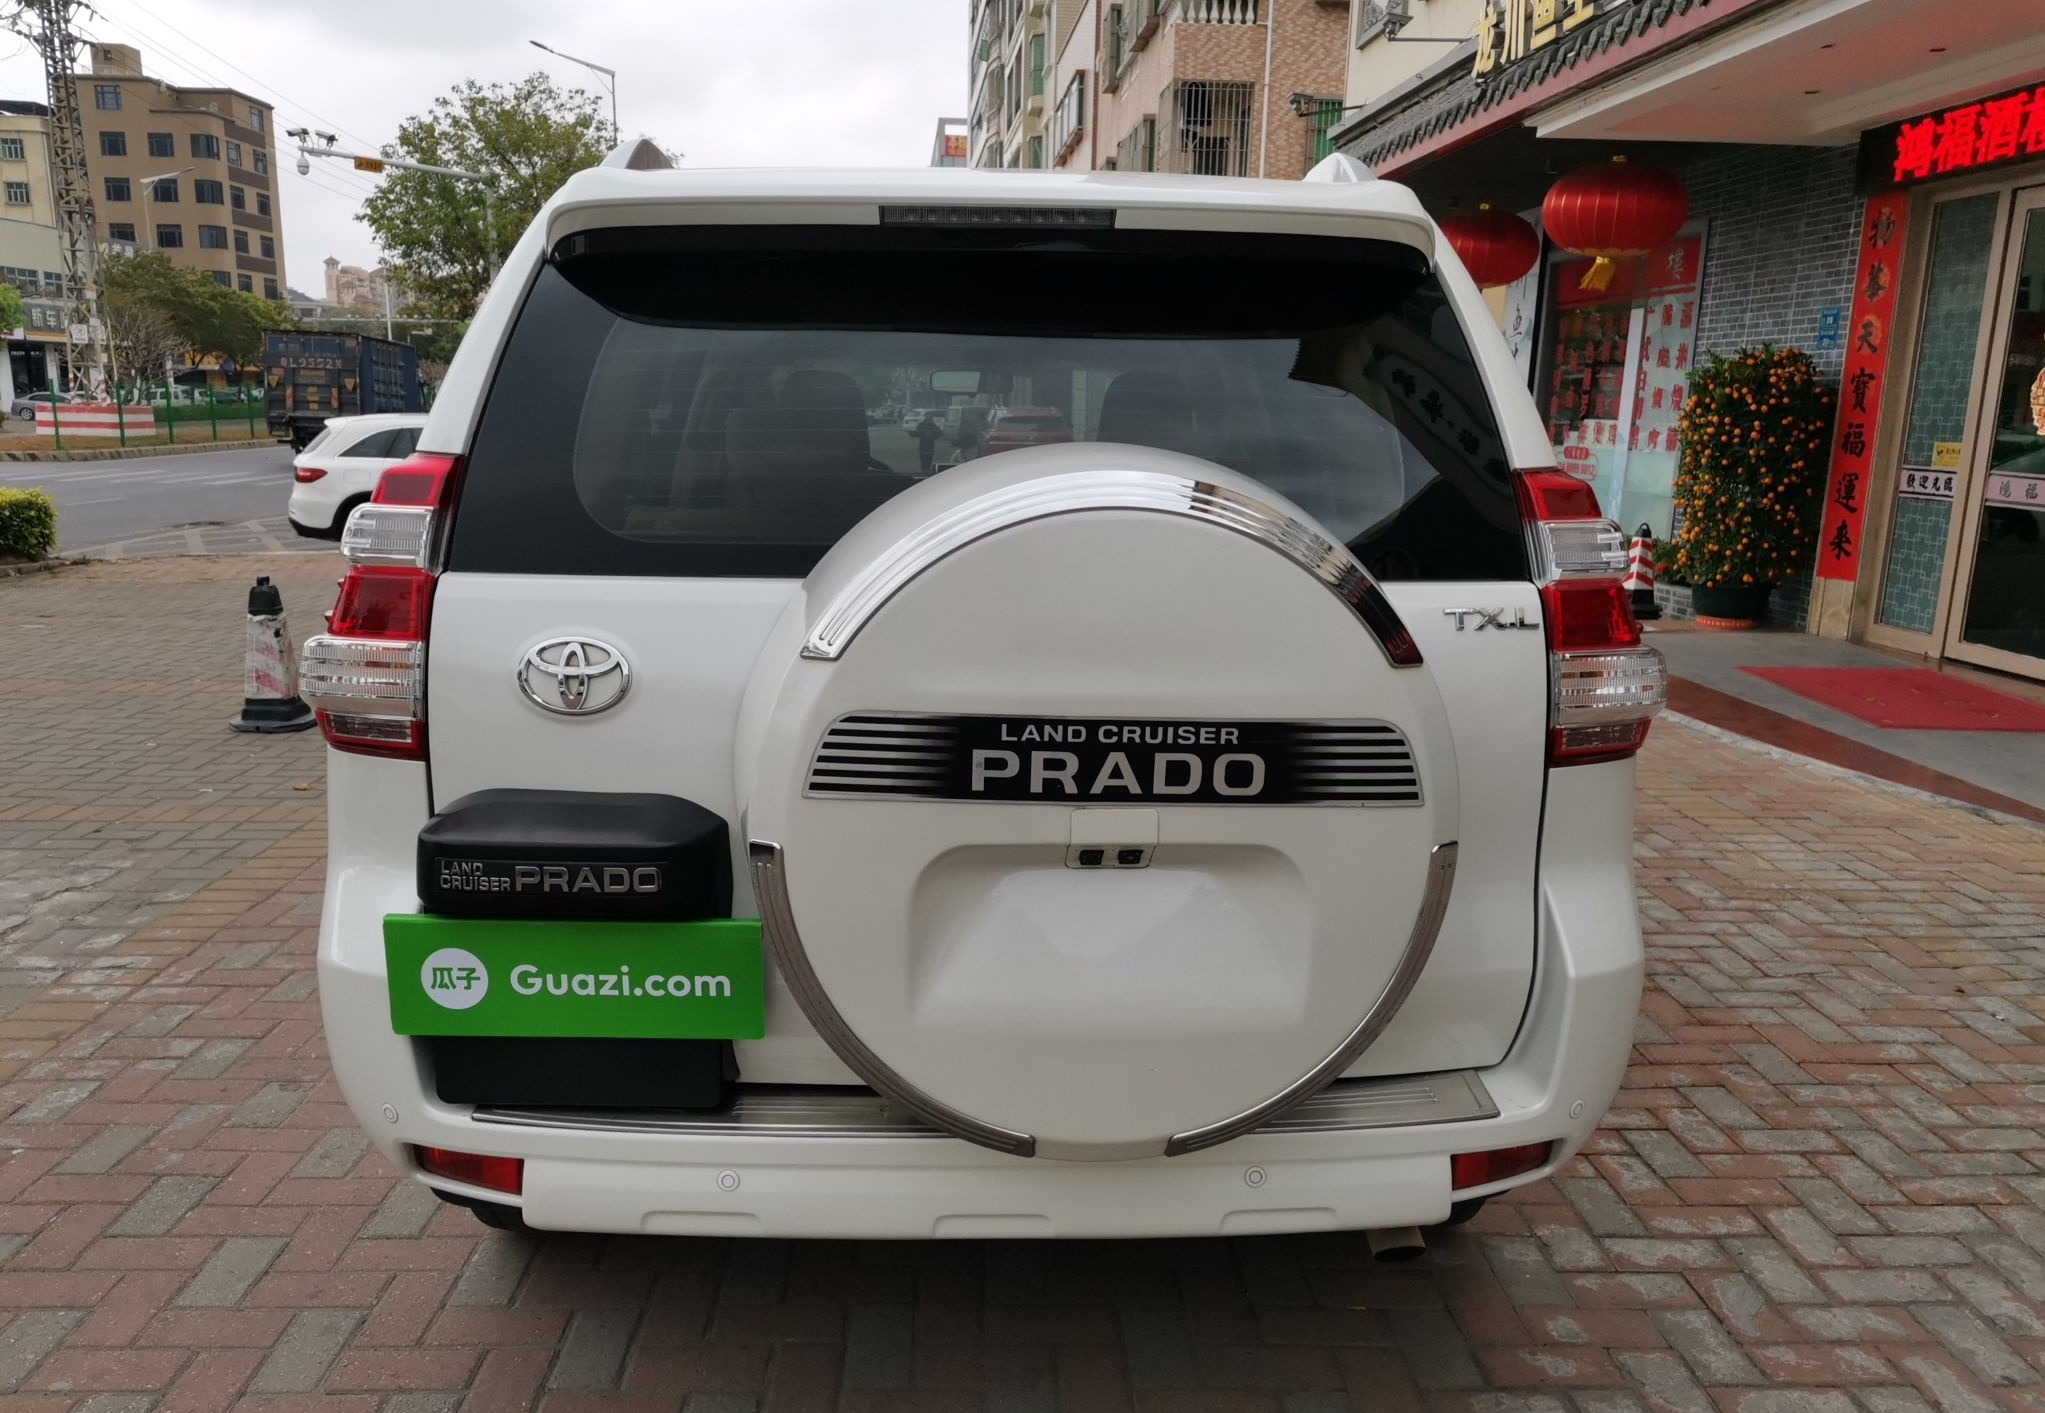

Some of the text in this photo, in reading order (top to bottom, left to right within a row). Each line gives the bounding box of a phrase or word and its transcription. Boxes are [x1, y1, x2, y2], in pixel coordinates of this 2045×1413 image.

[1000, 723, 1240, 745] LAND CRUISER
[971, 748, 1266, 797] PRADO
[440, 860, 483, 876] LAND
[514, 865, 662, 894] PRADO
[440, 875, 511, 892] CRUISER
[430, 966, 481, 991] 瓜子
[509, 963, 732, 998] Guazi.com
